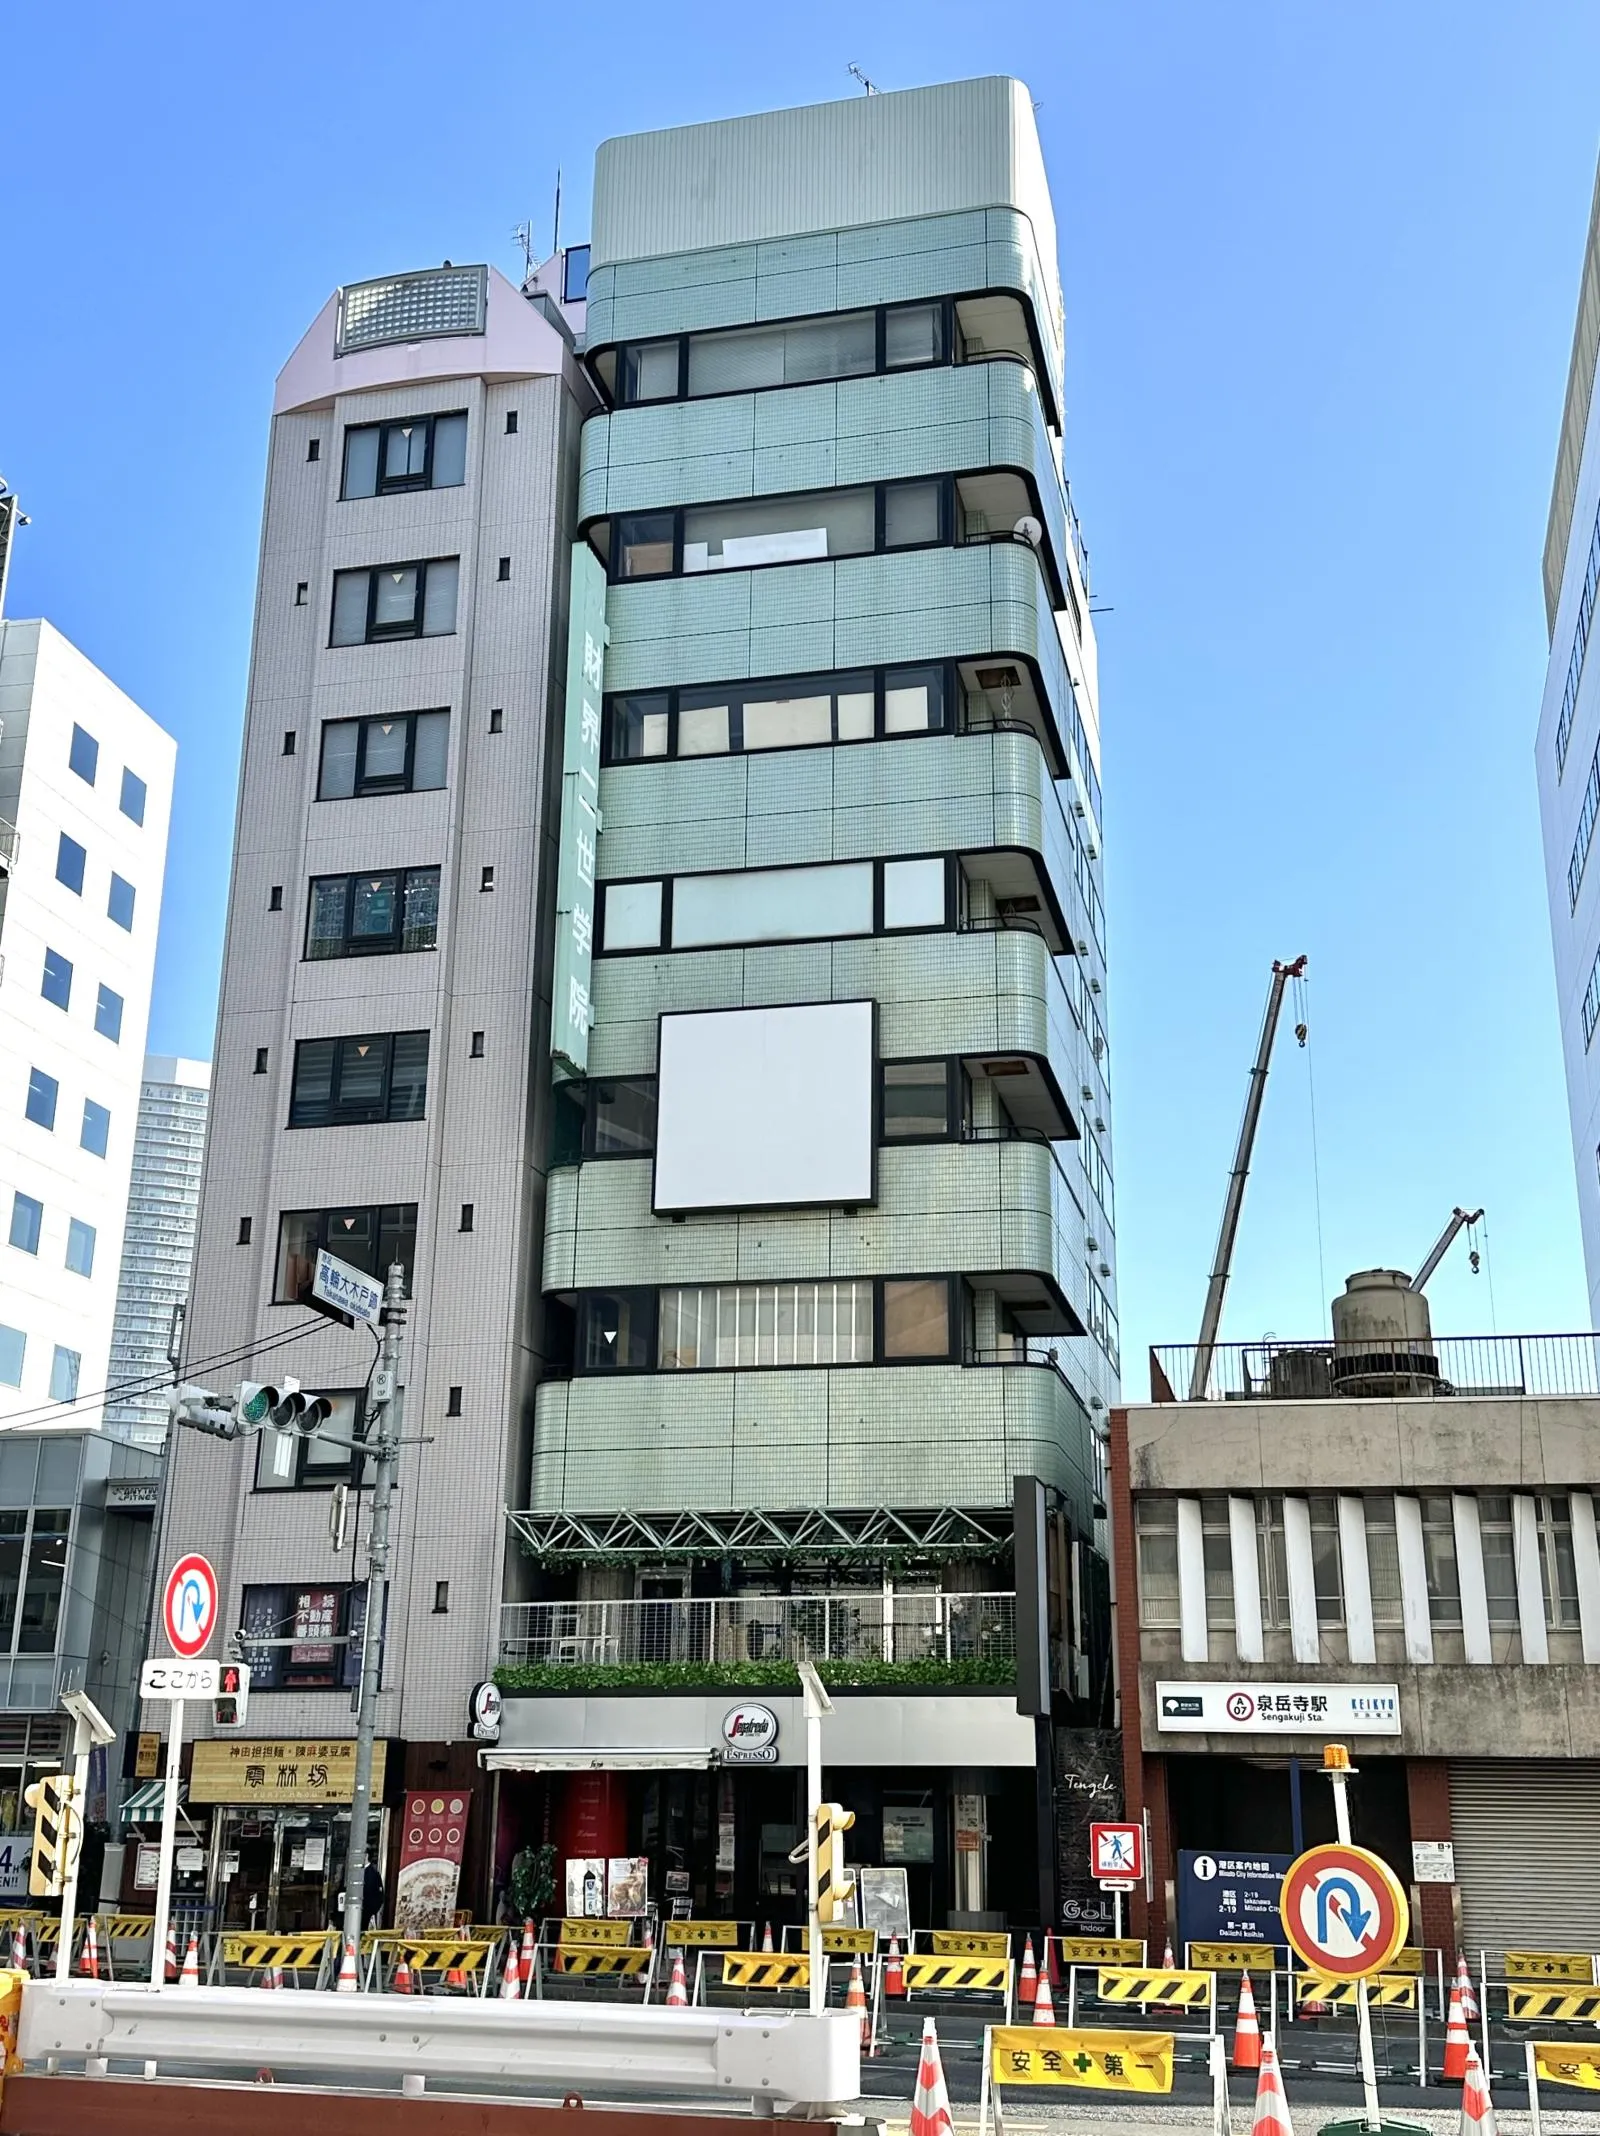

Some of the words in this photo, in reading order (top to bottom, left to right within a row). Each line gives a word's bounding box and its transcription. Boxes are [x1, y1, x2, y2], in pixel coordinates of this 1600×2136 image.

[149, 1670, 212, 1689] ここから
[1236, 1697, 1244, 1705] A
[1257, 1695, 1328, 1712] 泉岳寺駅
[1351, 1699, 1394, 1710] KEIKYU
[1234, 1705, 1248, 1715] 07
[1262, 1713, 1305, 1723] Sengakuji
[726, 1749, 771, 1760] ESPRESSO
[1080, 1924, 1107, 1933] Indoor
